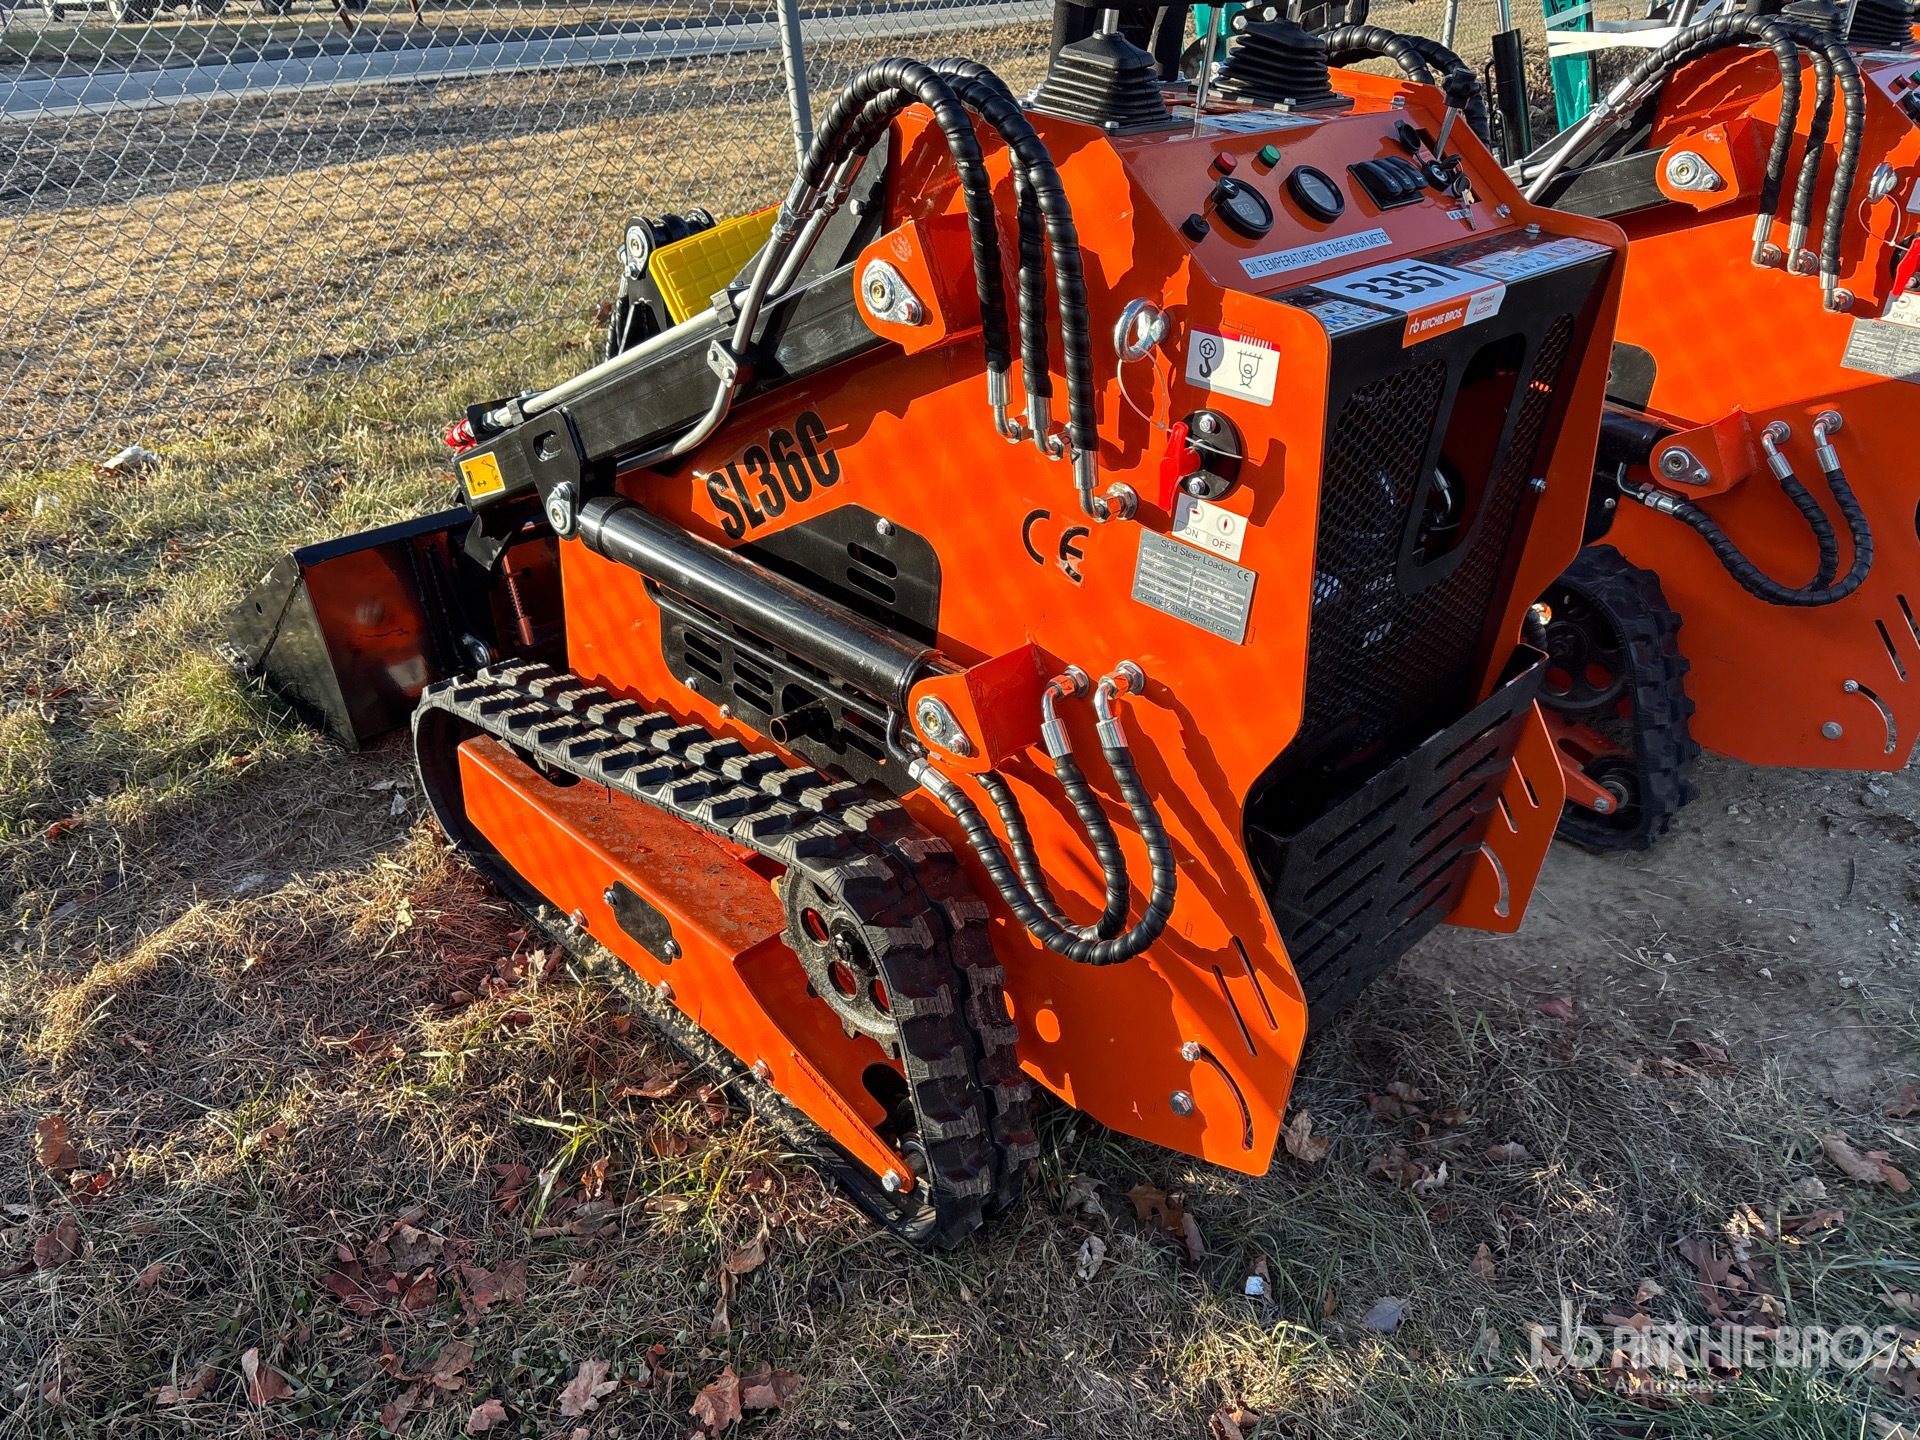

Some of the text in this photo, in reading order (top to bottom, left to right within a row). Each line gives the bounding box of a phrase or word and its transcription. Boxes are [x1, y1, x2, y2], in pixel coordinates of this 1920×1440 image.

[1245, 231, 1391, 274] OIL TEMPERATURE VOLTAGE HOUR METER
[1345, 265, 1461, 300] 3357
[1478, 293, 1496, 305] Timed
[1420, 311, 1446, 332] RITCHIE
[1444, 307, 1463, 325] BROS.
[1473, 304, 1493, 316] Auction
[1892, 312, 1905, 320] ON
[1871, 322, 1887, 331] Skid
[706, 411, 842, 540] SL36C
[1184, 526, 1199, 539] ON
[1021, 508, 1091, 583] CE
[1211, 538, 1232, 552] OFF
[1160, 539, 1178, 553] Skid
[1179, 546, 1202, 563] Steer
[1202, 557, 1232, 574] Loader
